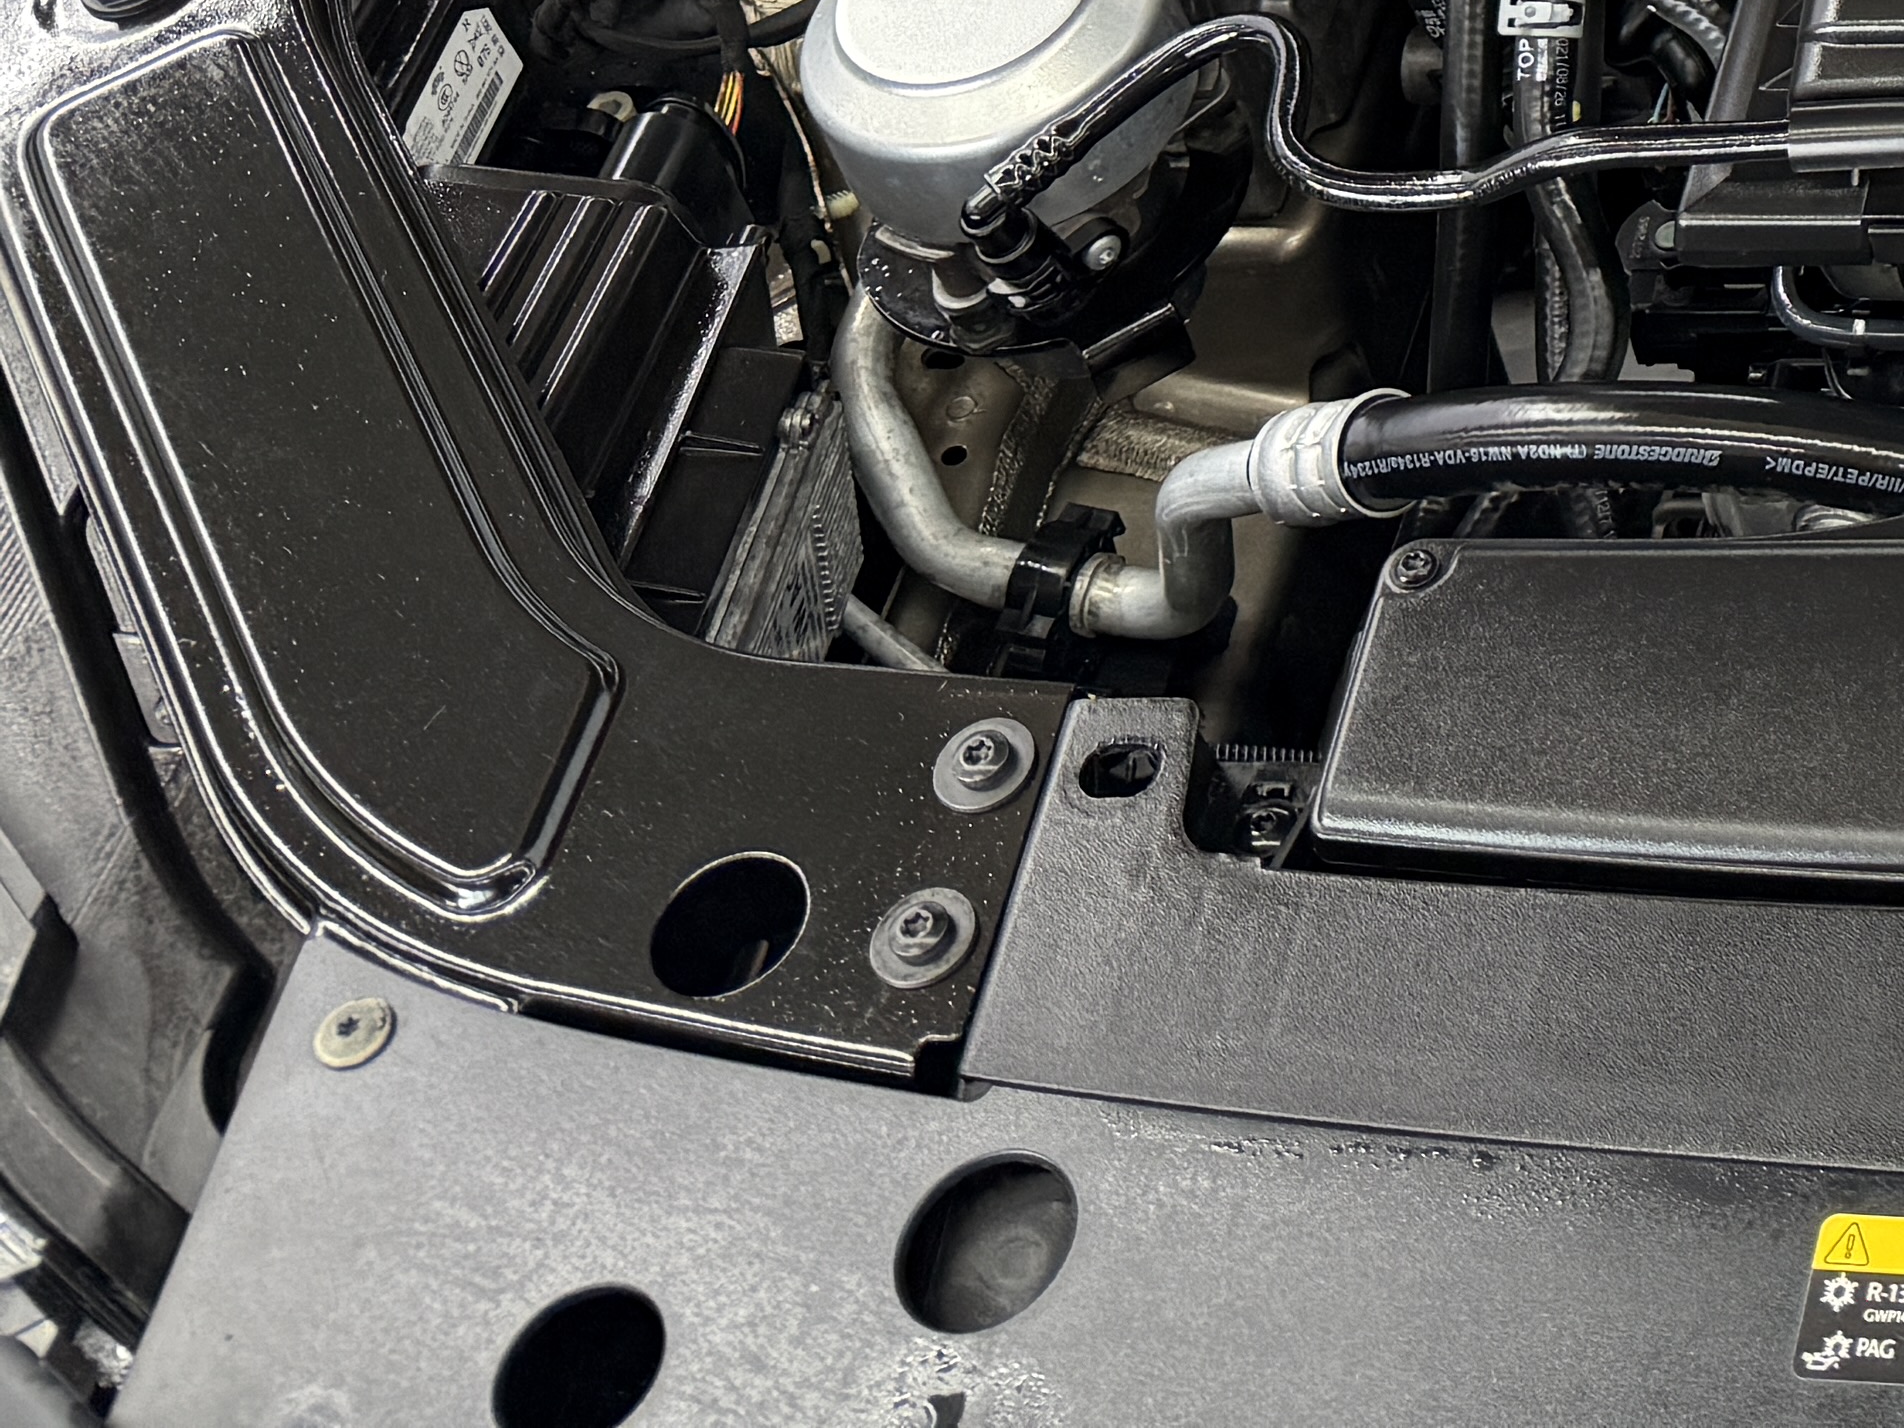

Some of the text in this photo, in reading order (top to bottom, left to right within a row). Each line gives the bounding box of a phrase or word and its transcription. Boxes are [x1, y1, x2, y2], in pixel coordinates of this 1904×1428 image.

[1516, 38, 1534, 81] TOP
[1595, 444, 1723, 466] BRIDGESTONE
[1856, 1336, 1897, 1360] PAG
